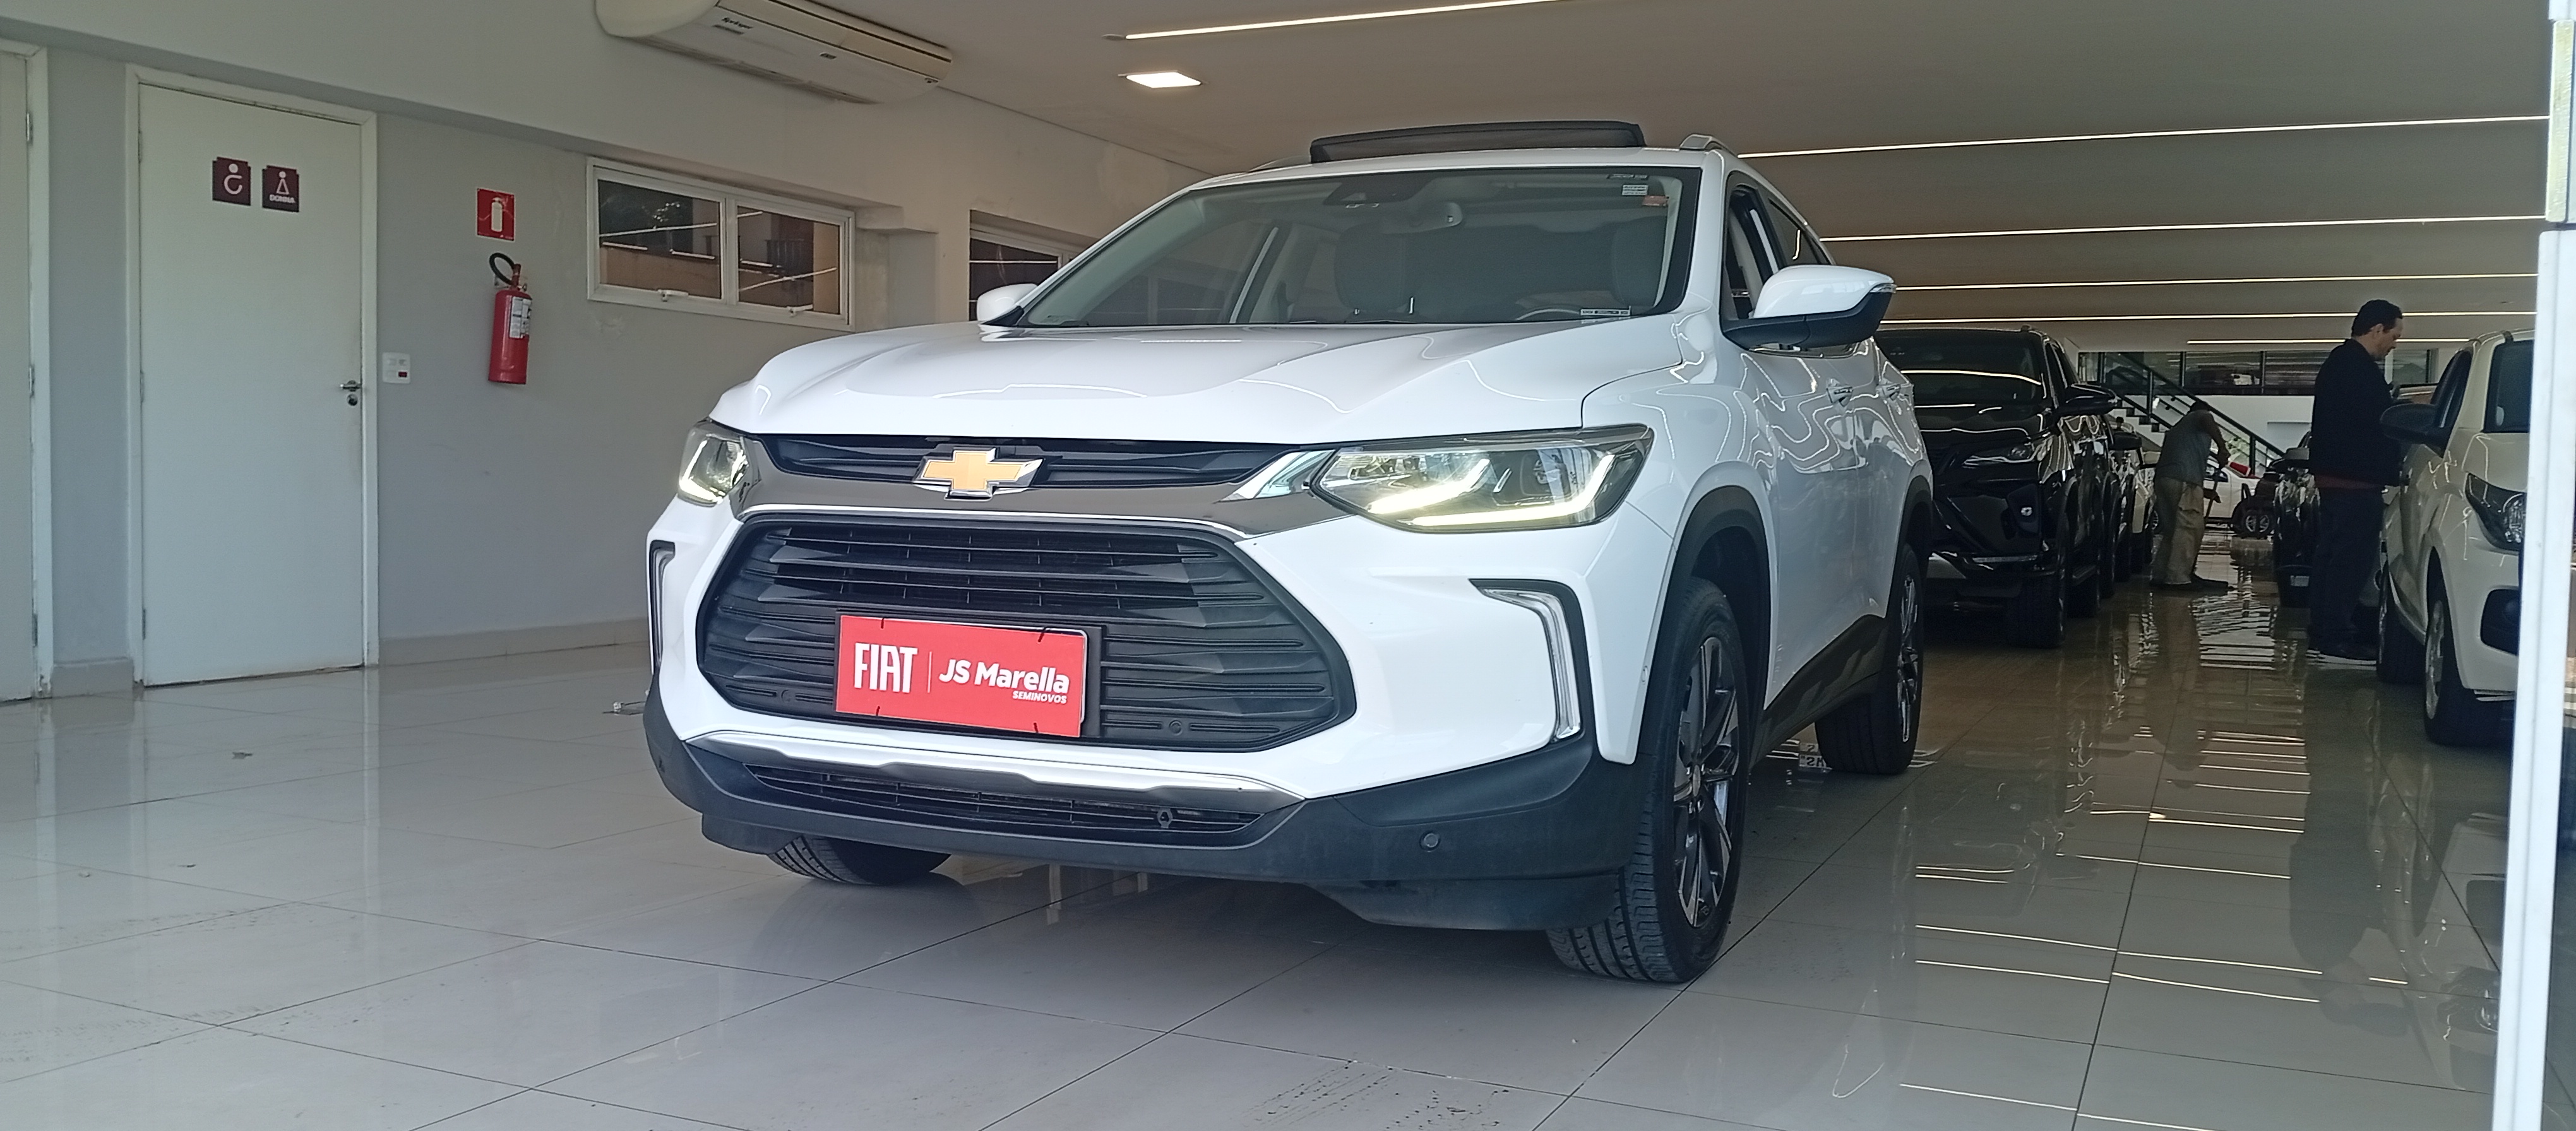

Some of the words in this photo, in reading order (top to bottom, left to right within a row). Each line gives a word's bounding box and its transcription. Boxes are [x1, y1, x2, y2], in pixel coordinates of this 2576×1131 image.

[854, 642, 918, 693] FIAT
[939, 659, 971, 684] JS
[974, 662, 1070, 694] Marella
[1012, 690, 1067, 704] SEMINOVOS
